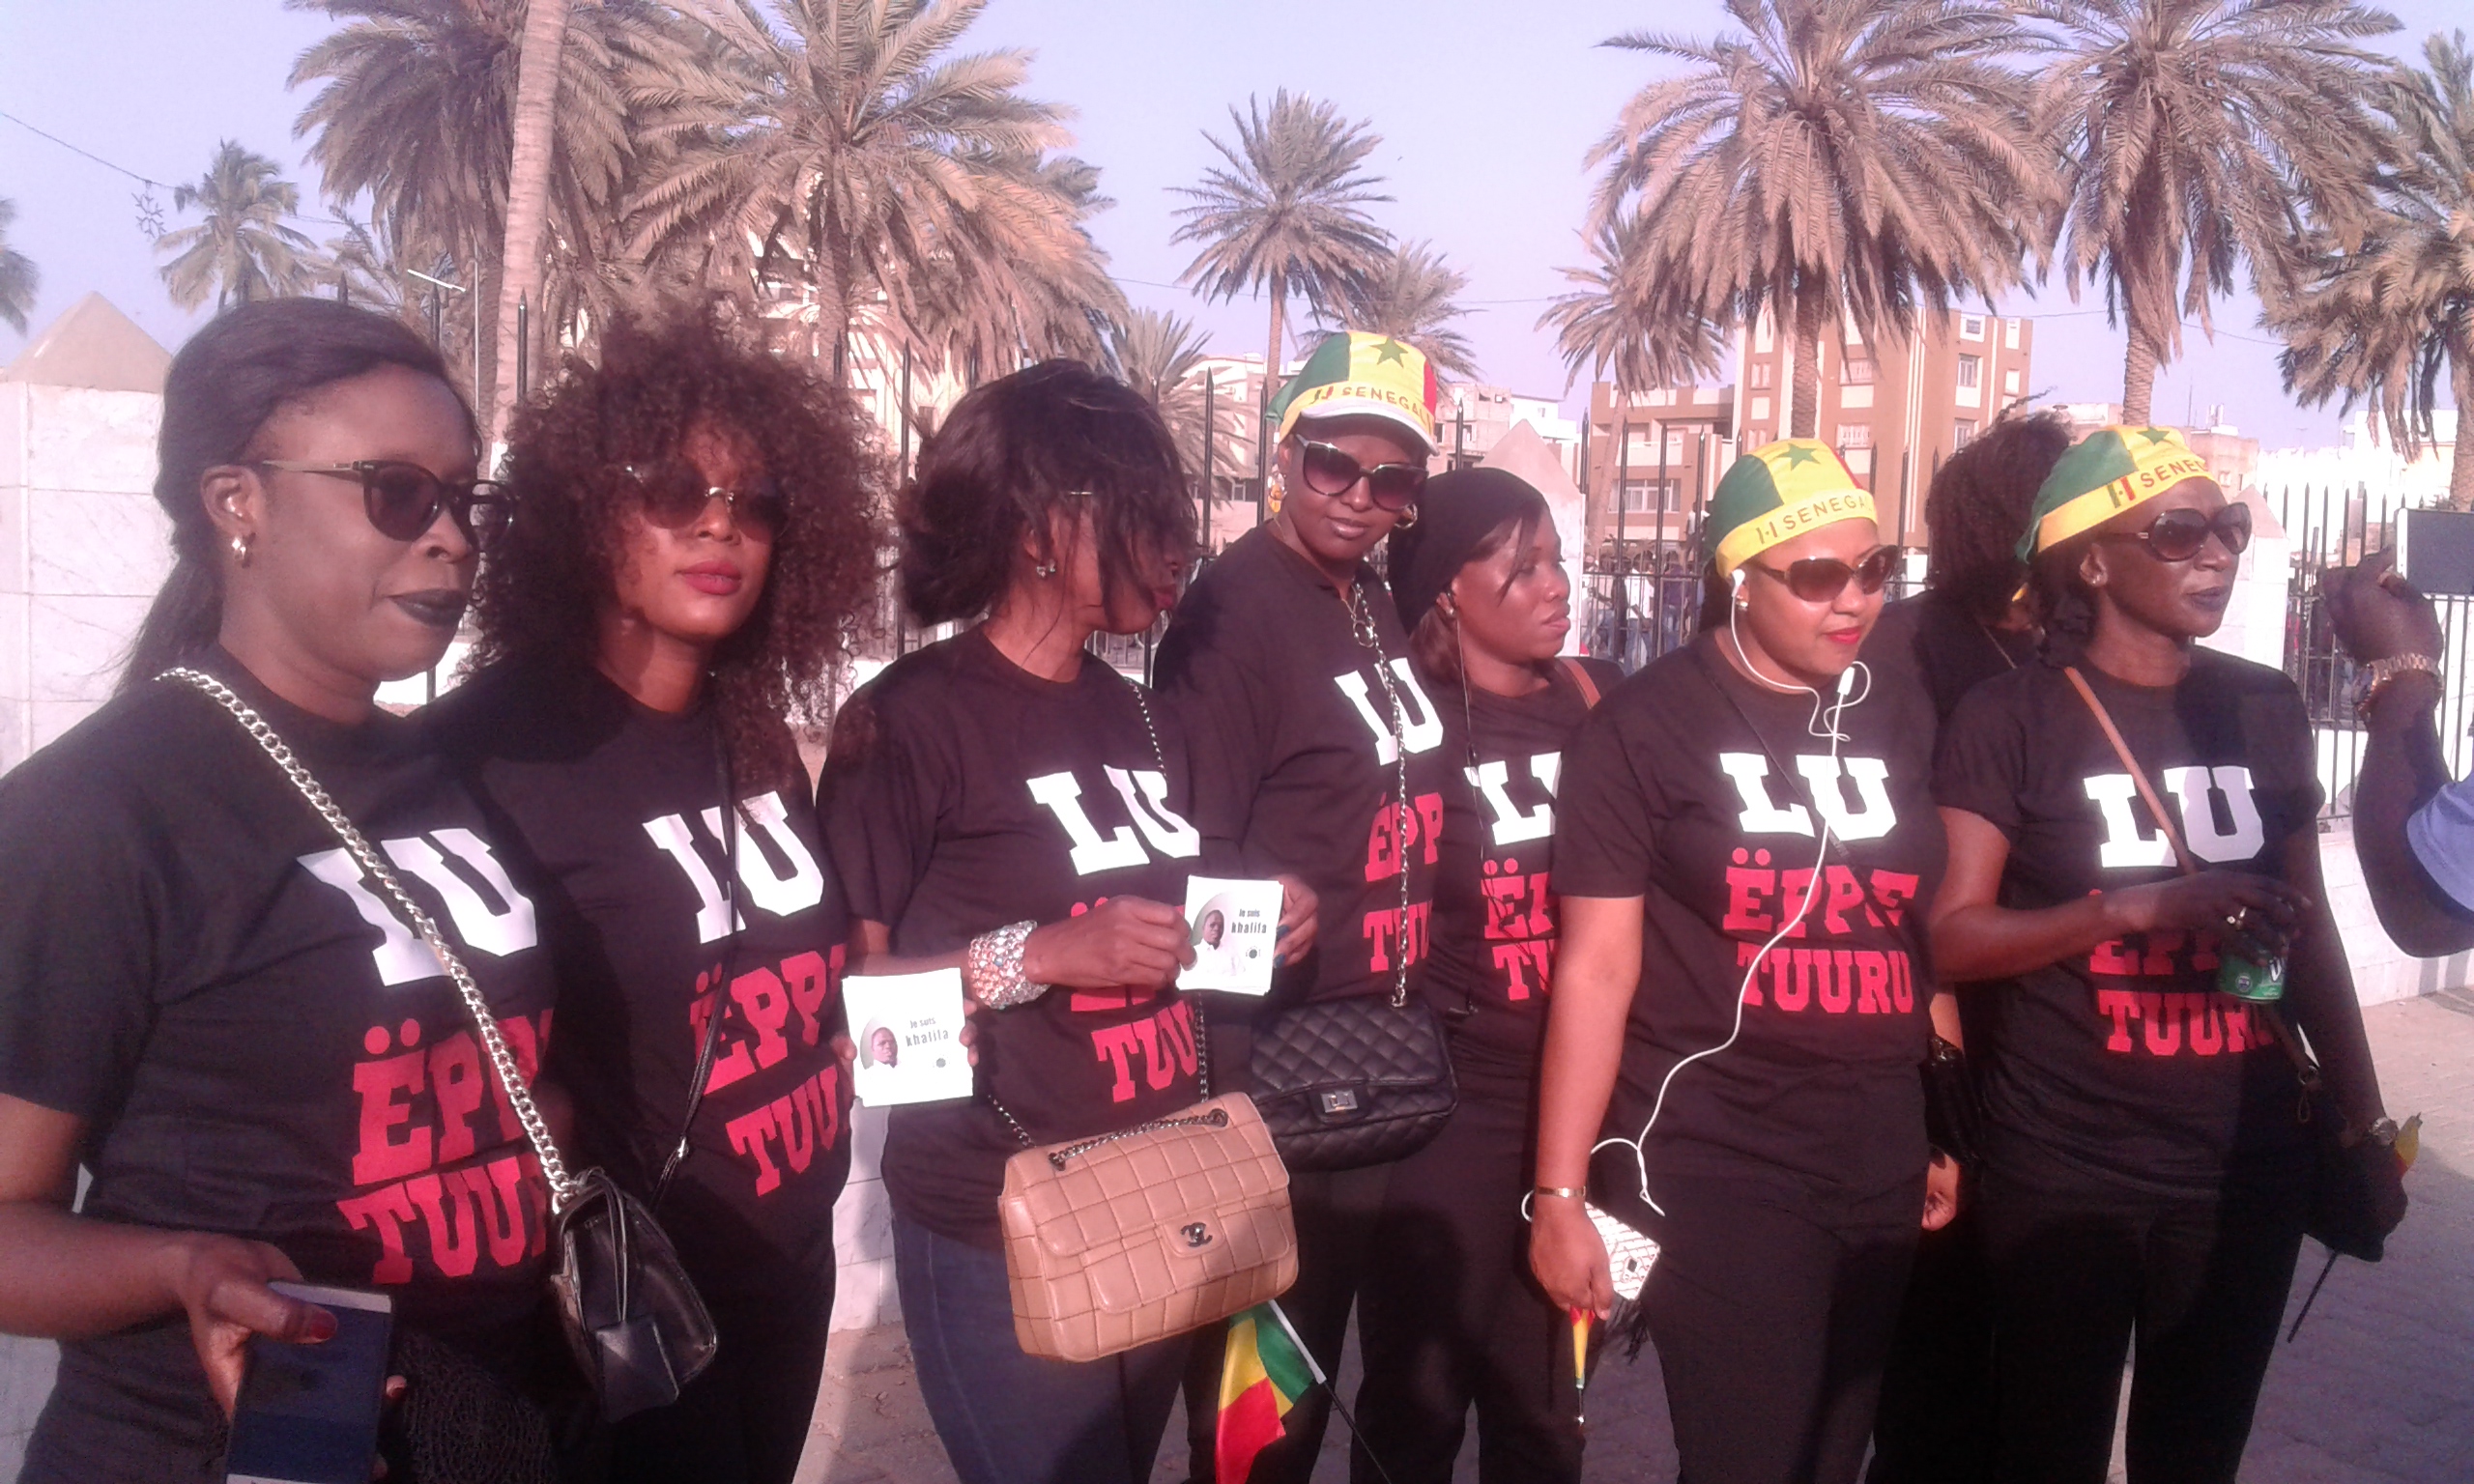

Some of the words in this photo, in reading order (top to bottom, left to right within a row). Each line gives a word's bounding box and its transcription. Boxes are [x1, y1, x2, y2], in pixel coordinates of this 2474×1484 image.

[1341, 386, 1427, 426] SENEGAL
[1335, 657, 1444, 766] LU
[1026, 764, 1200, 876] LU
[1720, 752, 1898, 842] LU
[2084, 765, 2265, 868] LU
[297, 828, 537, 986] LU
[641, 790, 824, 945] LU
[1722, 847, 1920, 939] ËPPE
[690, 943, 847, 1097] ËPP
[1736, 942, 1914, 1014] TUURU
[352, 1009, 555, 1186] ËPP
[1090, 999, 1196, 1103] TUU
[725, 1064, 850, 1197] TUU
